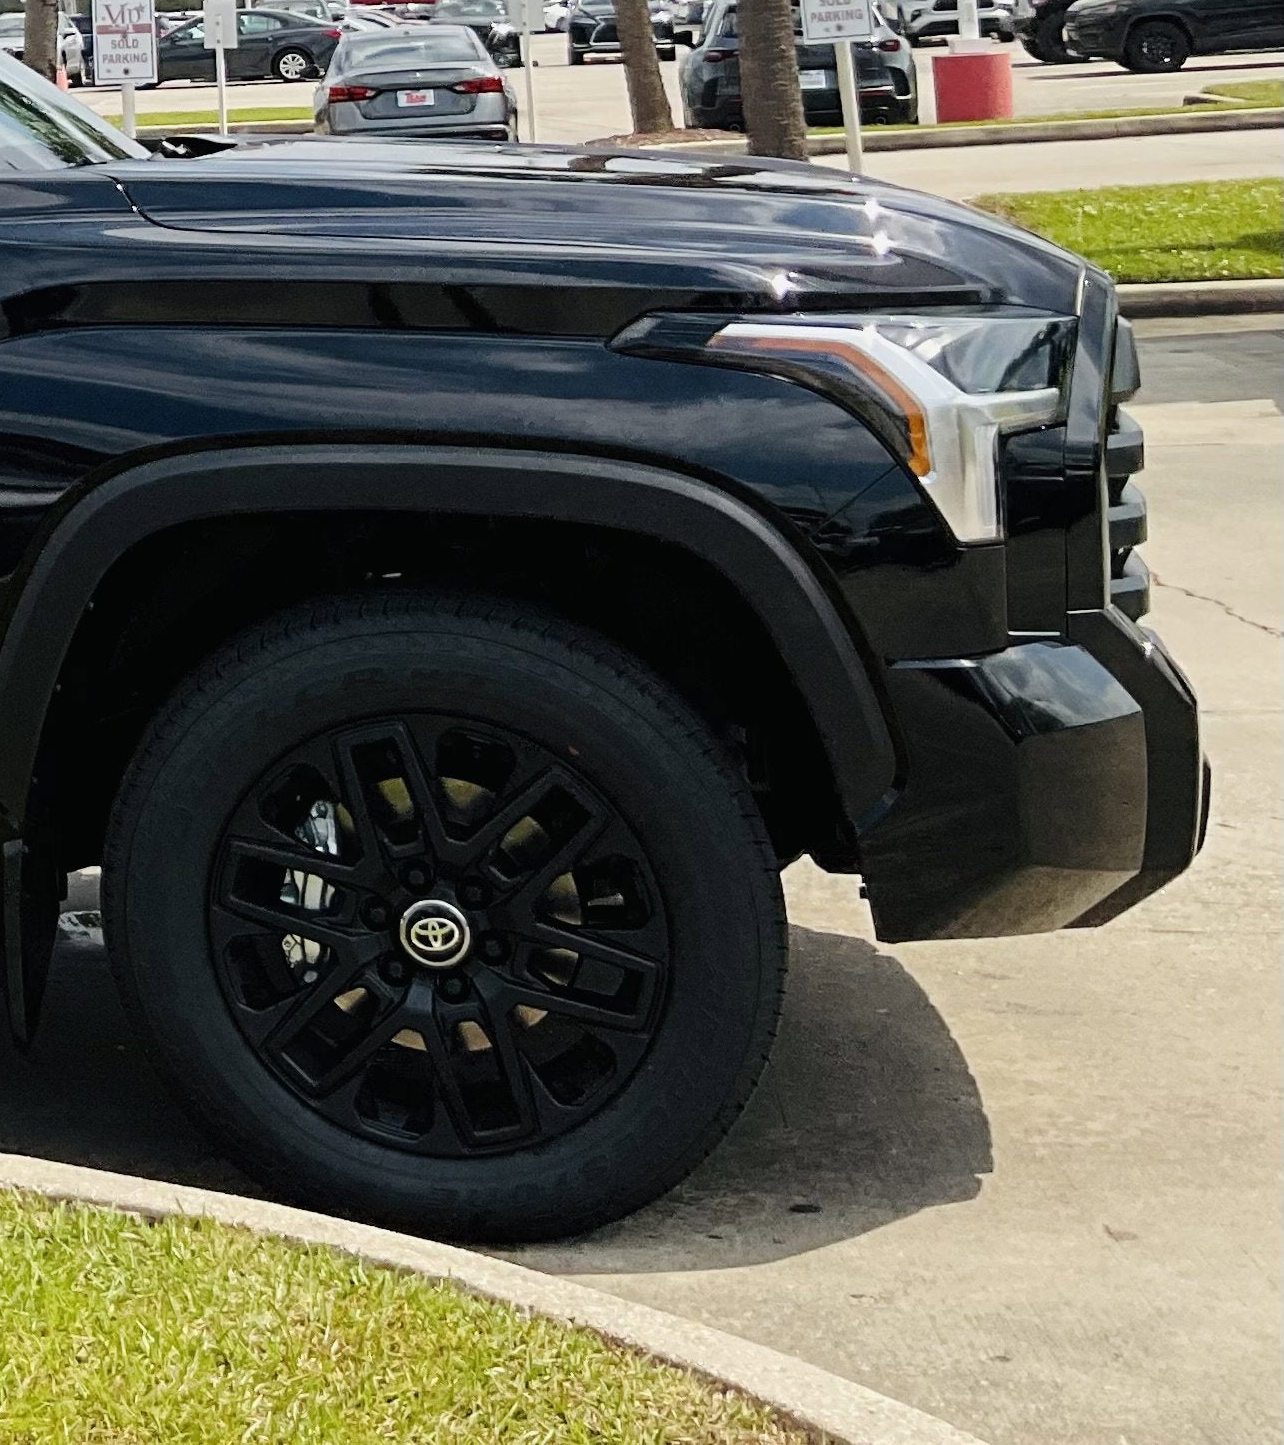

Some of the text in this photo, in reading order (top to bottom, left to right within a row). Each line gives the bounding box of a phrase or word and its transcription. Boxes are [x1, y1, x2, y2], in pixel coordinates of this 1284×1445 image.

[810, 9, 863, 23] PARKING
[111, 39, 139, 49] SOLD
[102, 53, 148, 64] PARKING
